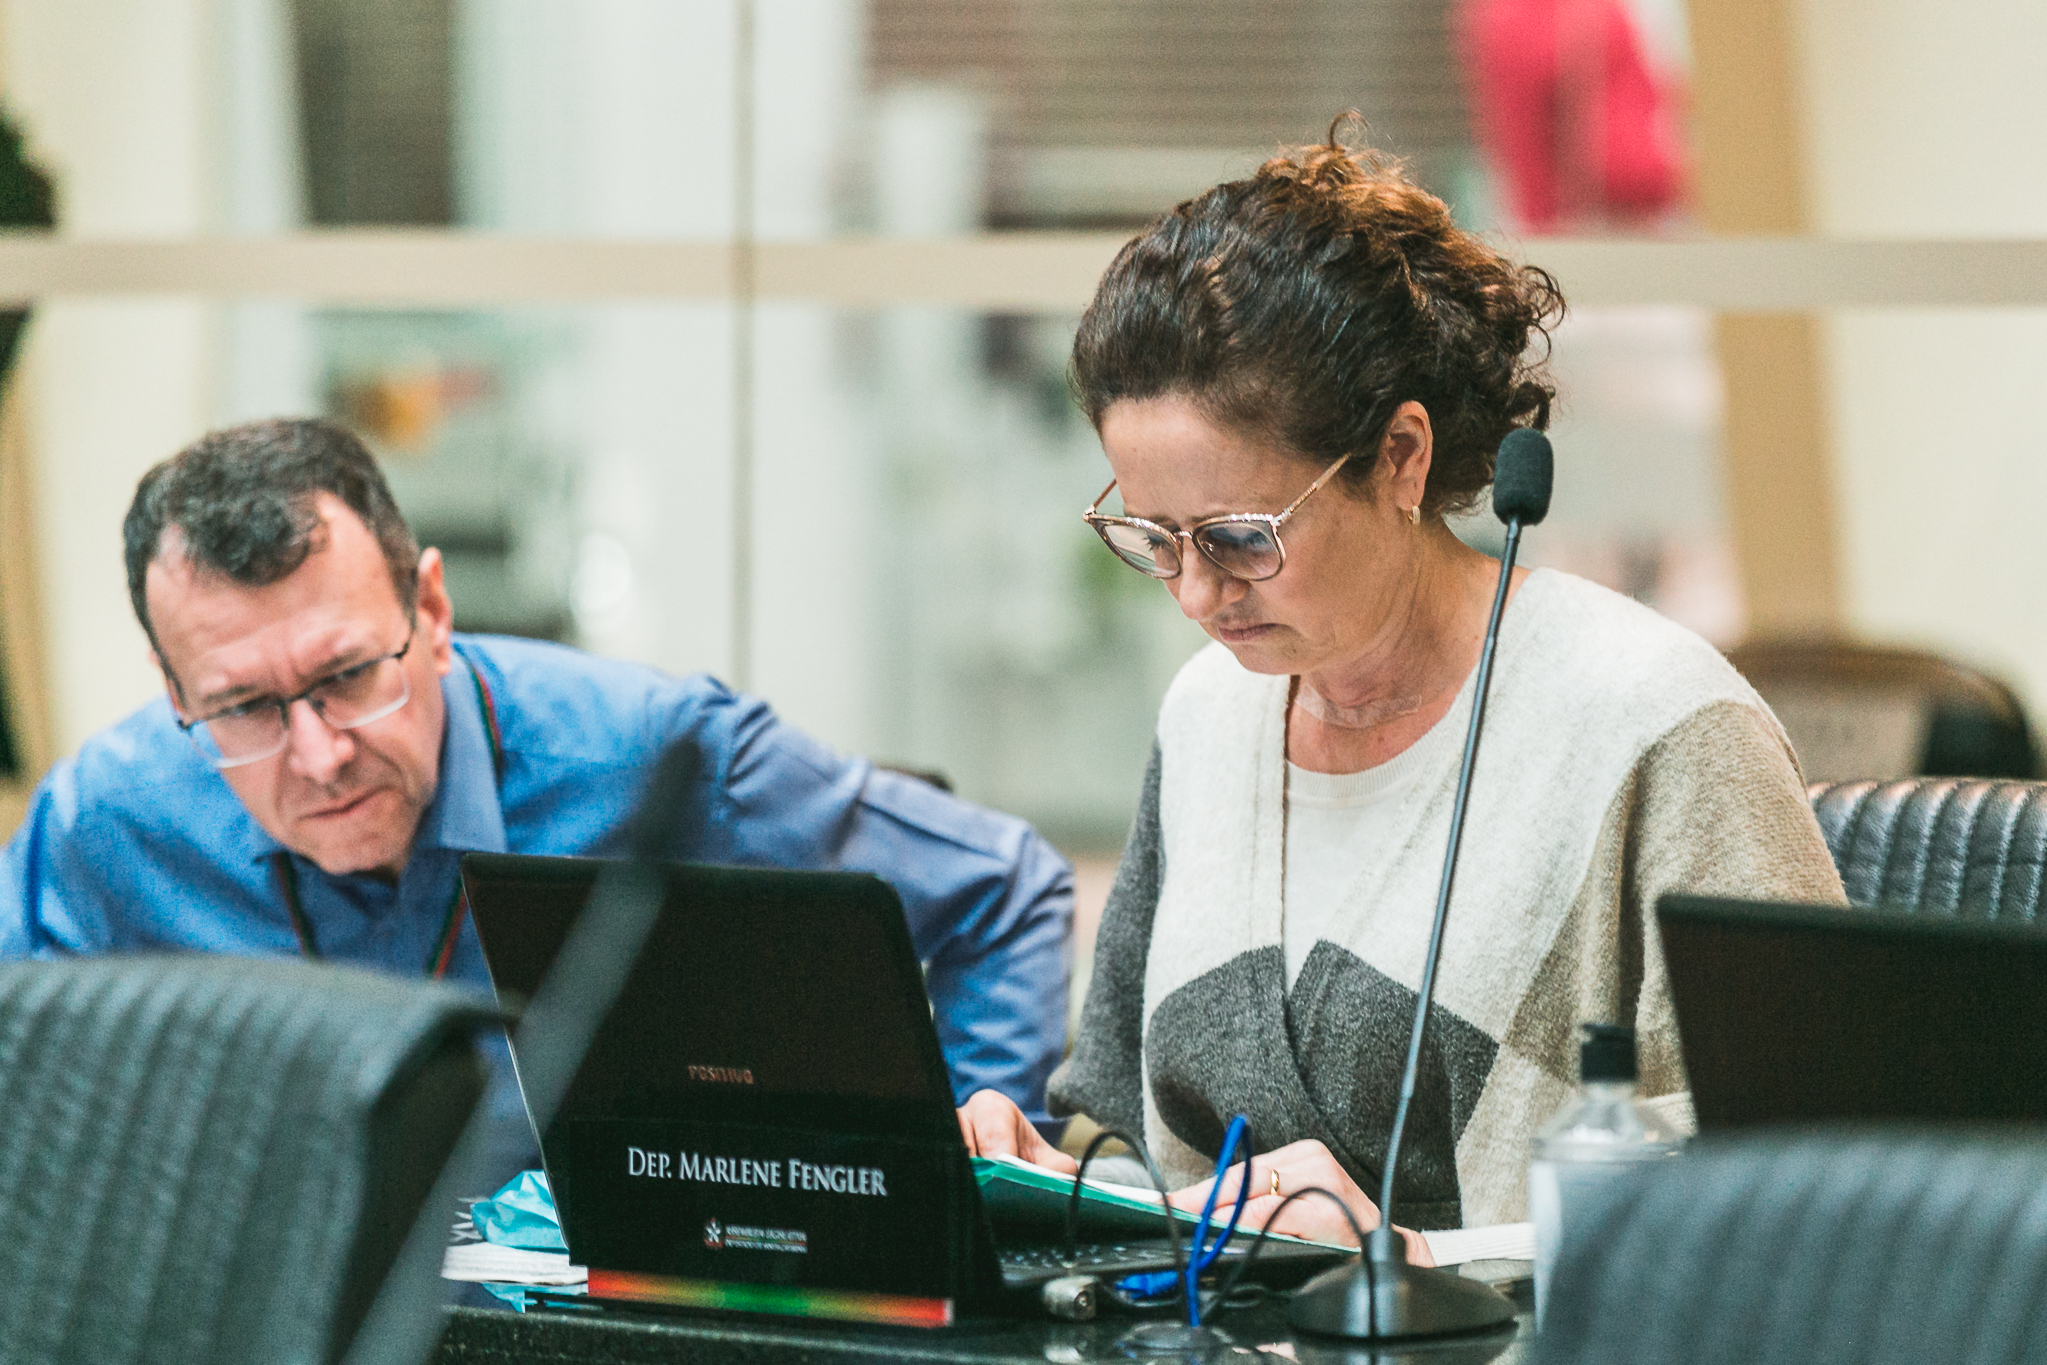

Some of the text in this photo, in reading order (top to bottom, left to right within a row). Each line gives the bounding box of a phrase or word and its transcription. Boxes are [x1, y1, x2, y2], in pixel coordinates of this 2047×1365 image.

[628, 1146, 888, 1196] DEP. MARLENE FENGLER
